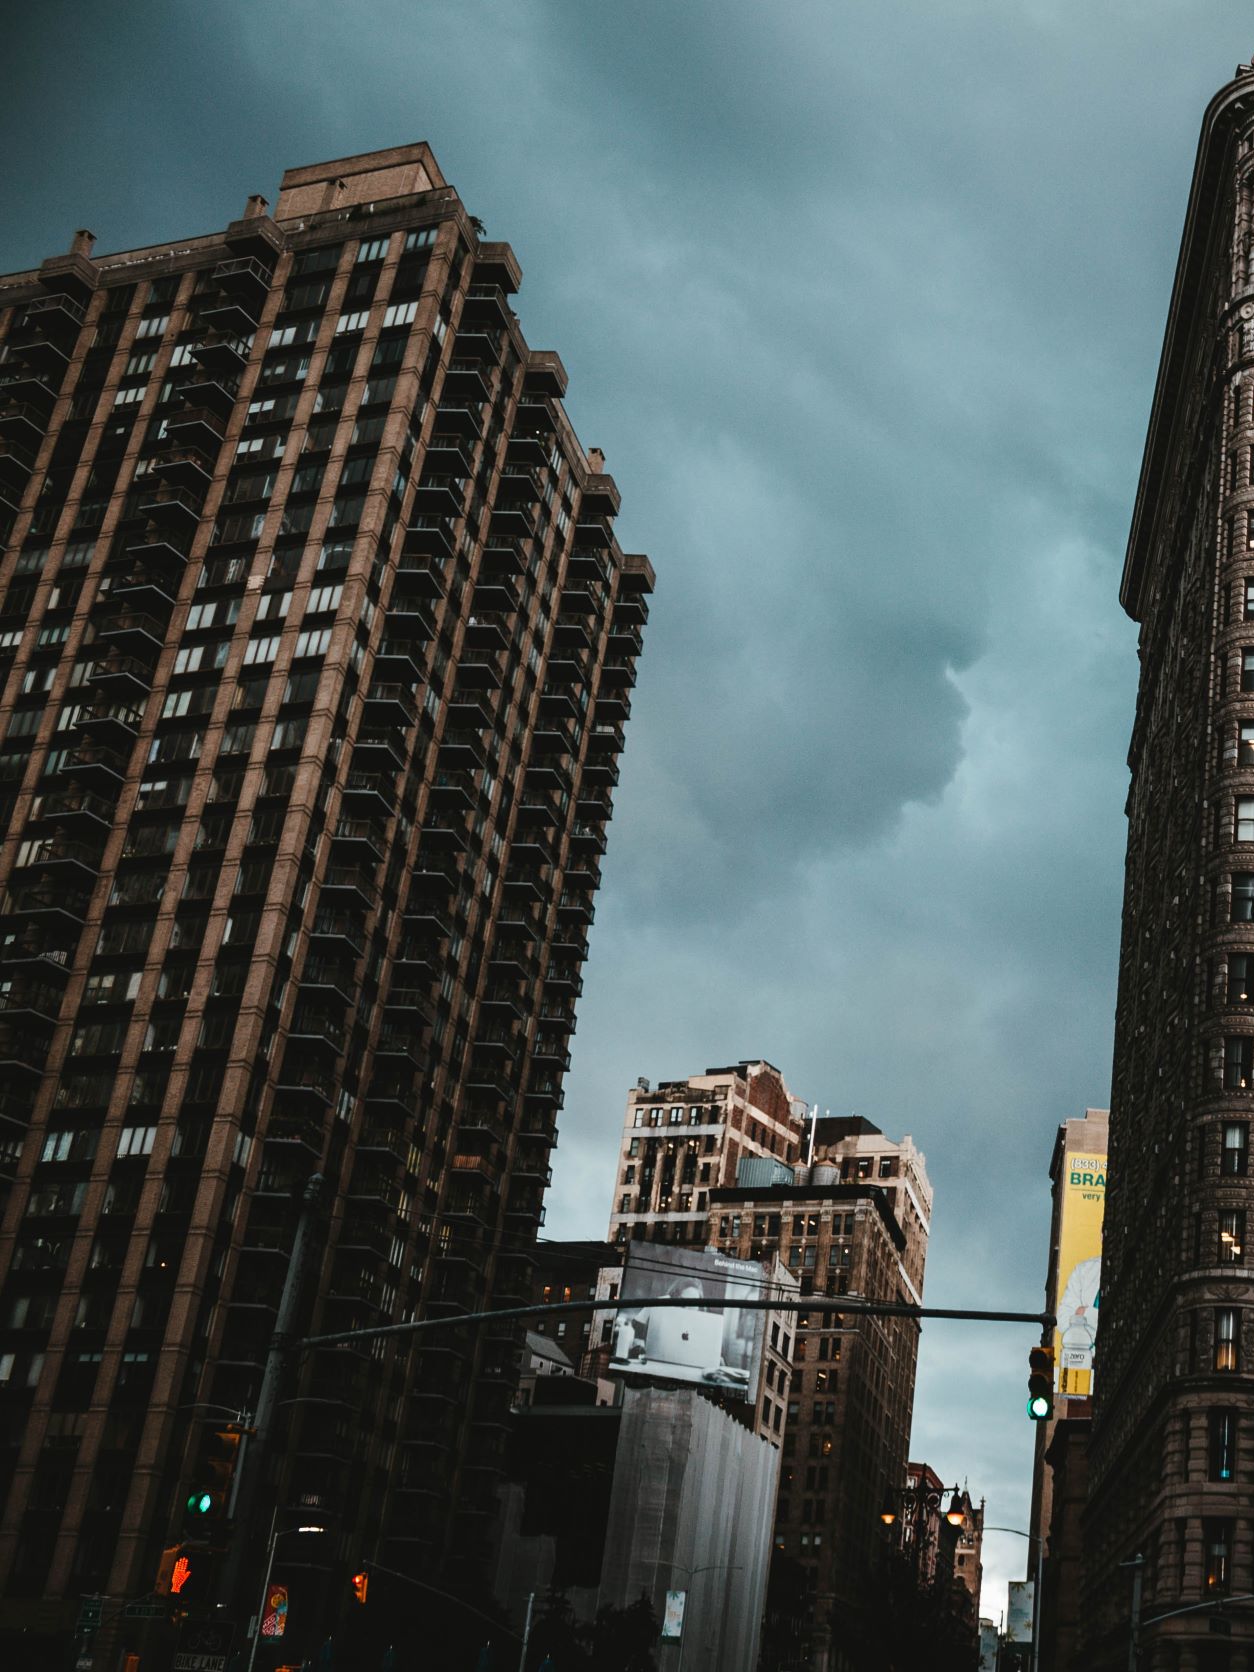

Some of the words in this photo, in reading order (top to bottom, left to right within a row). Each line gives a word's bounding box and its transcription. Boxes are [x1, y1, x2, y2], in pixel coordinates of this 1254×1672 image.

[1083, 1193, 1101, 1202] very
[176, 1655, 197, 1669] BIKE
[199, 1656, 224, 1670] LANE
